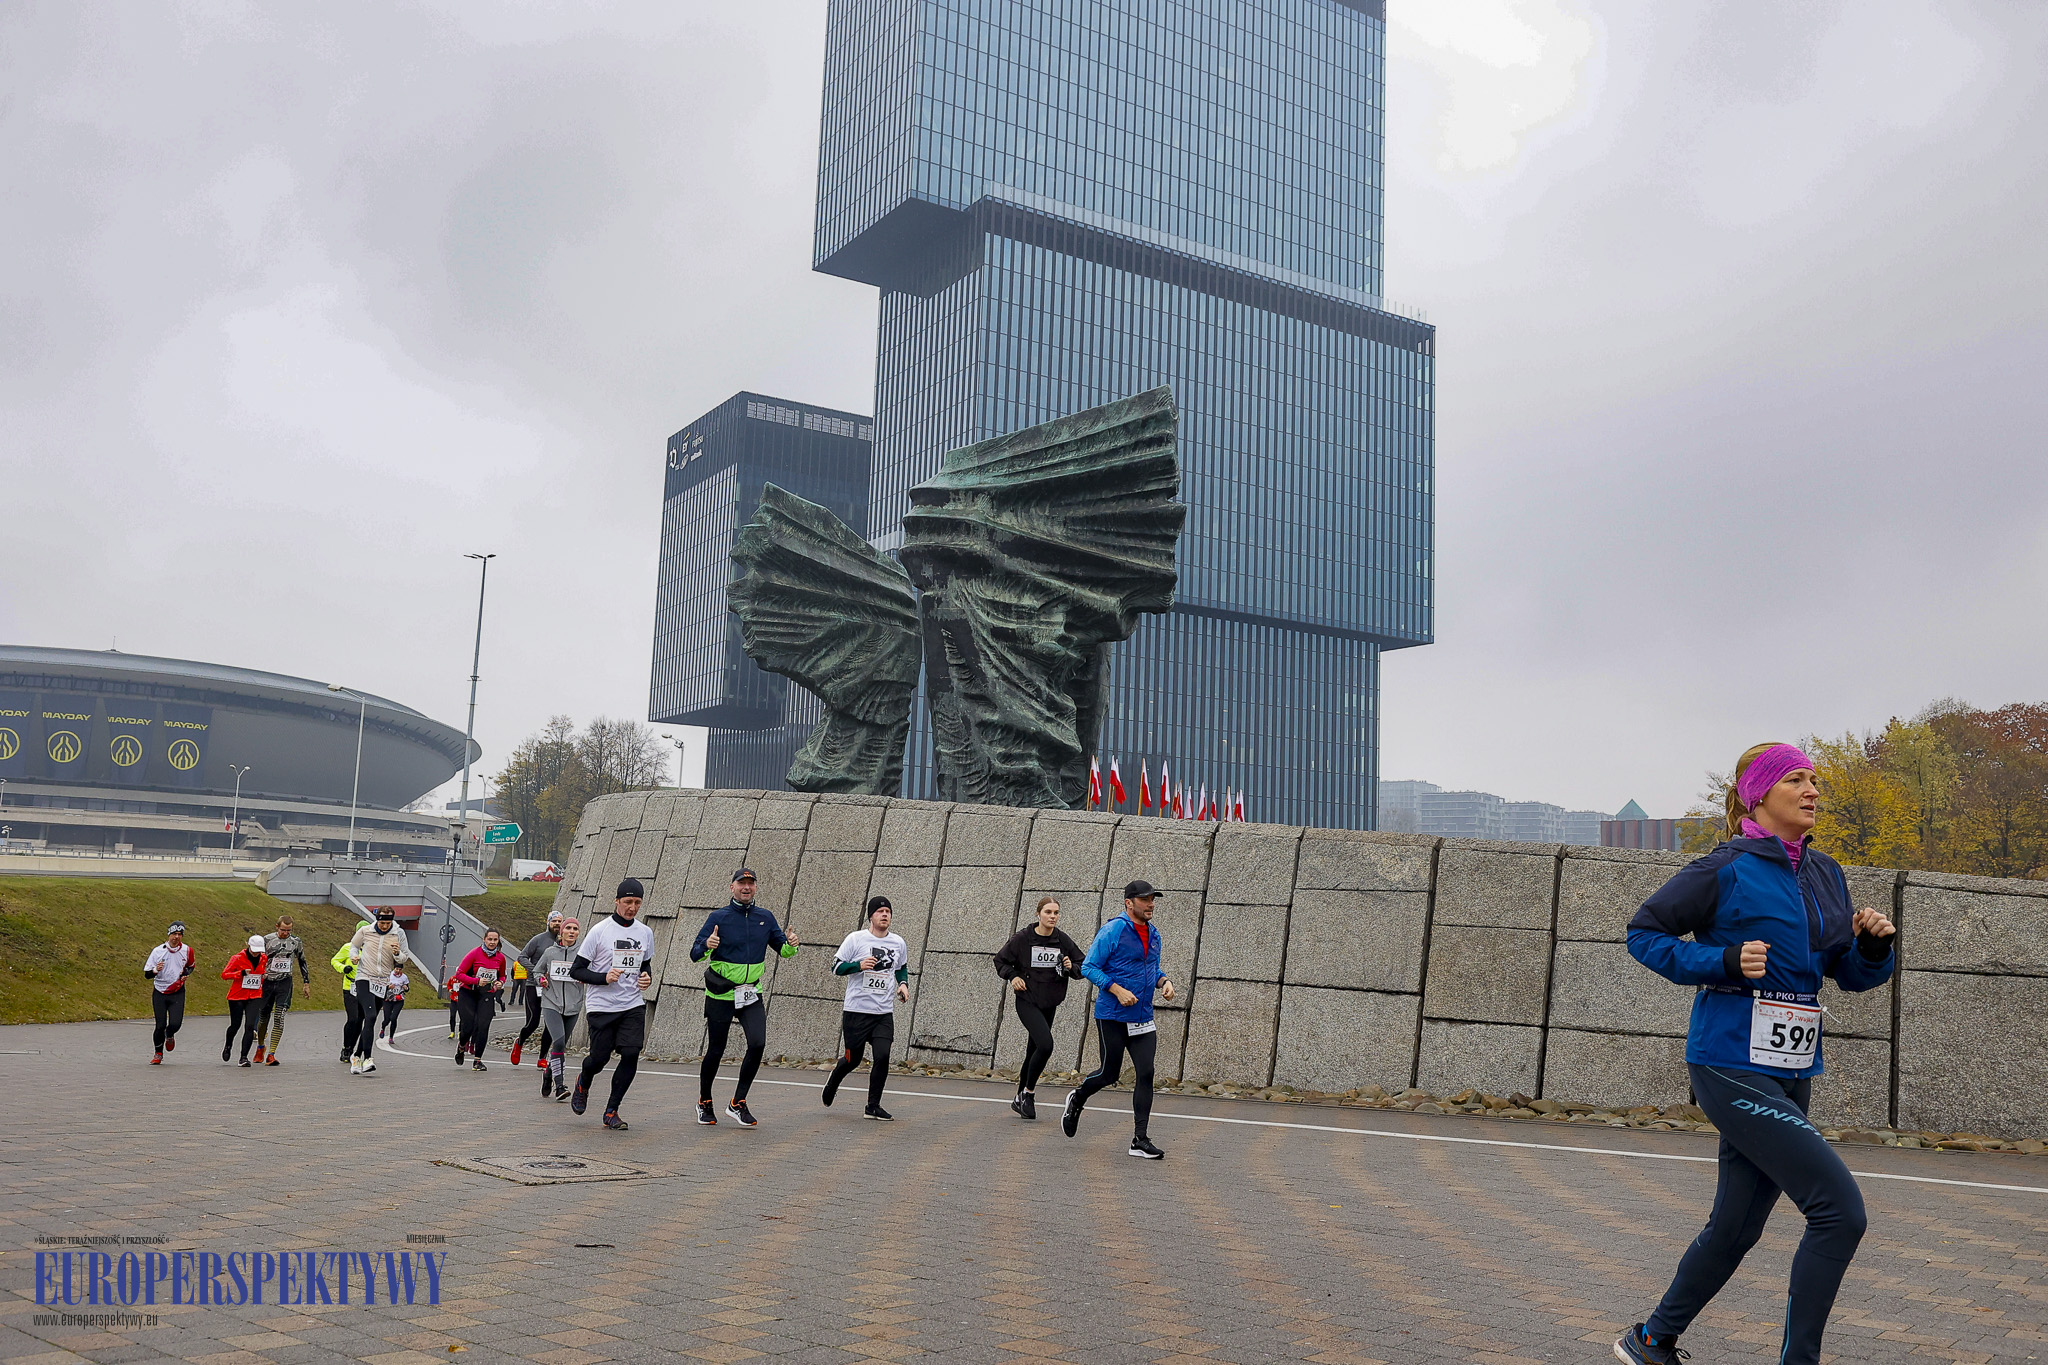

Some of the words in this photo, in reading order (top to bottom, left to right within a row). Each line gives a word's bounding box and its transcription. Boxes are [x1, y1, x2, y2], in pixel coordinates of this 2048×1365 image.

[42, 711, 92, 721] MAYDAY
[107, 716, 153, 726] MAYDAY
[163, 720, 209, 731] MAYDAY
[621, 956, 635, 967] 48
[1037, 952, 1055, 962] 602
[868, 978, 885, 989] 266
[1776, 991, 1795, 1001] PKO
[1769, 1022, 1816, 1052] 599
[1731, 1099, 1825, 1142] DYNAF
